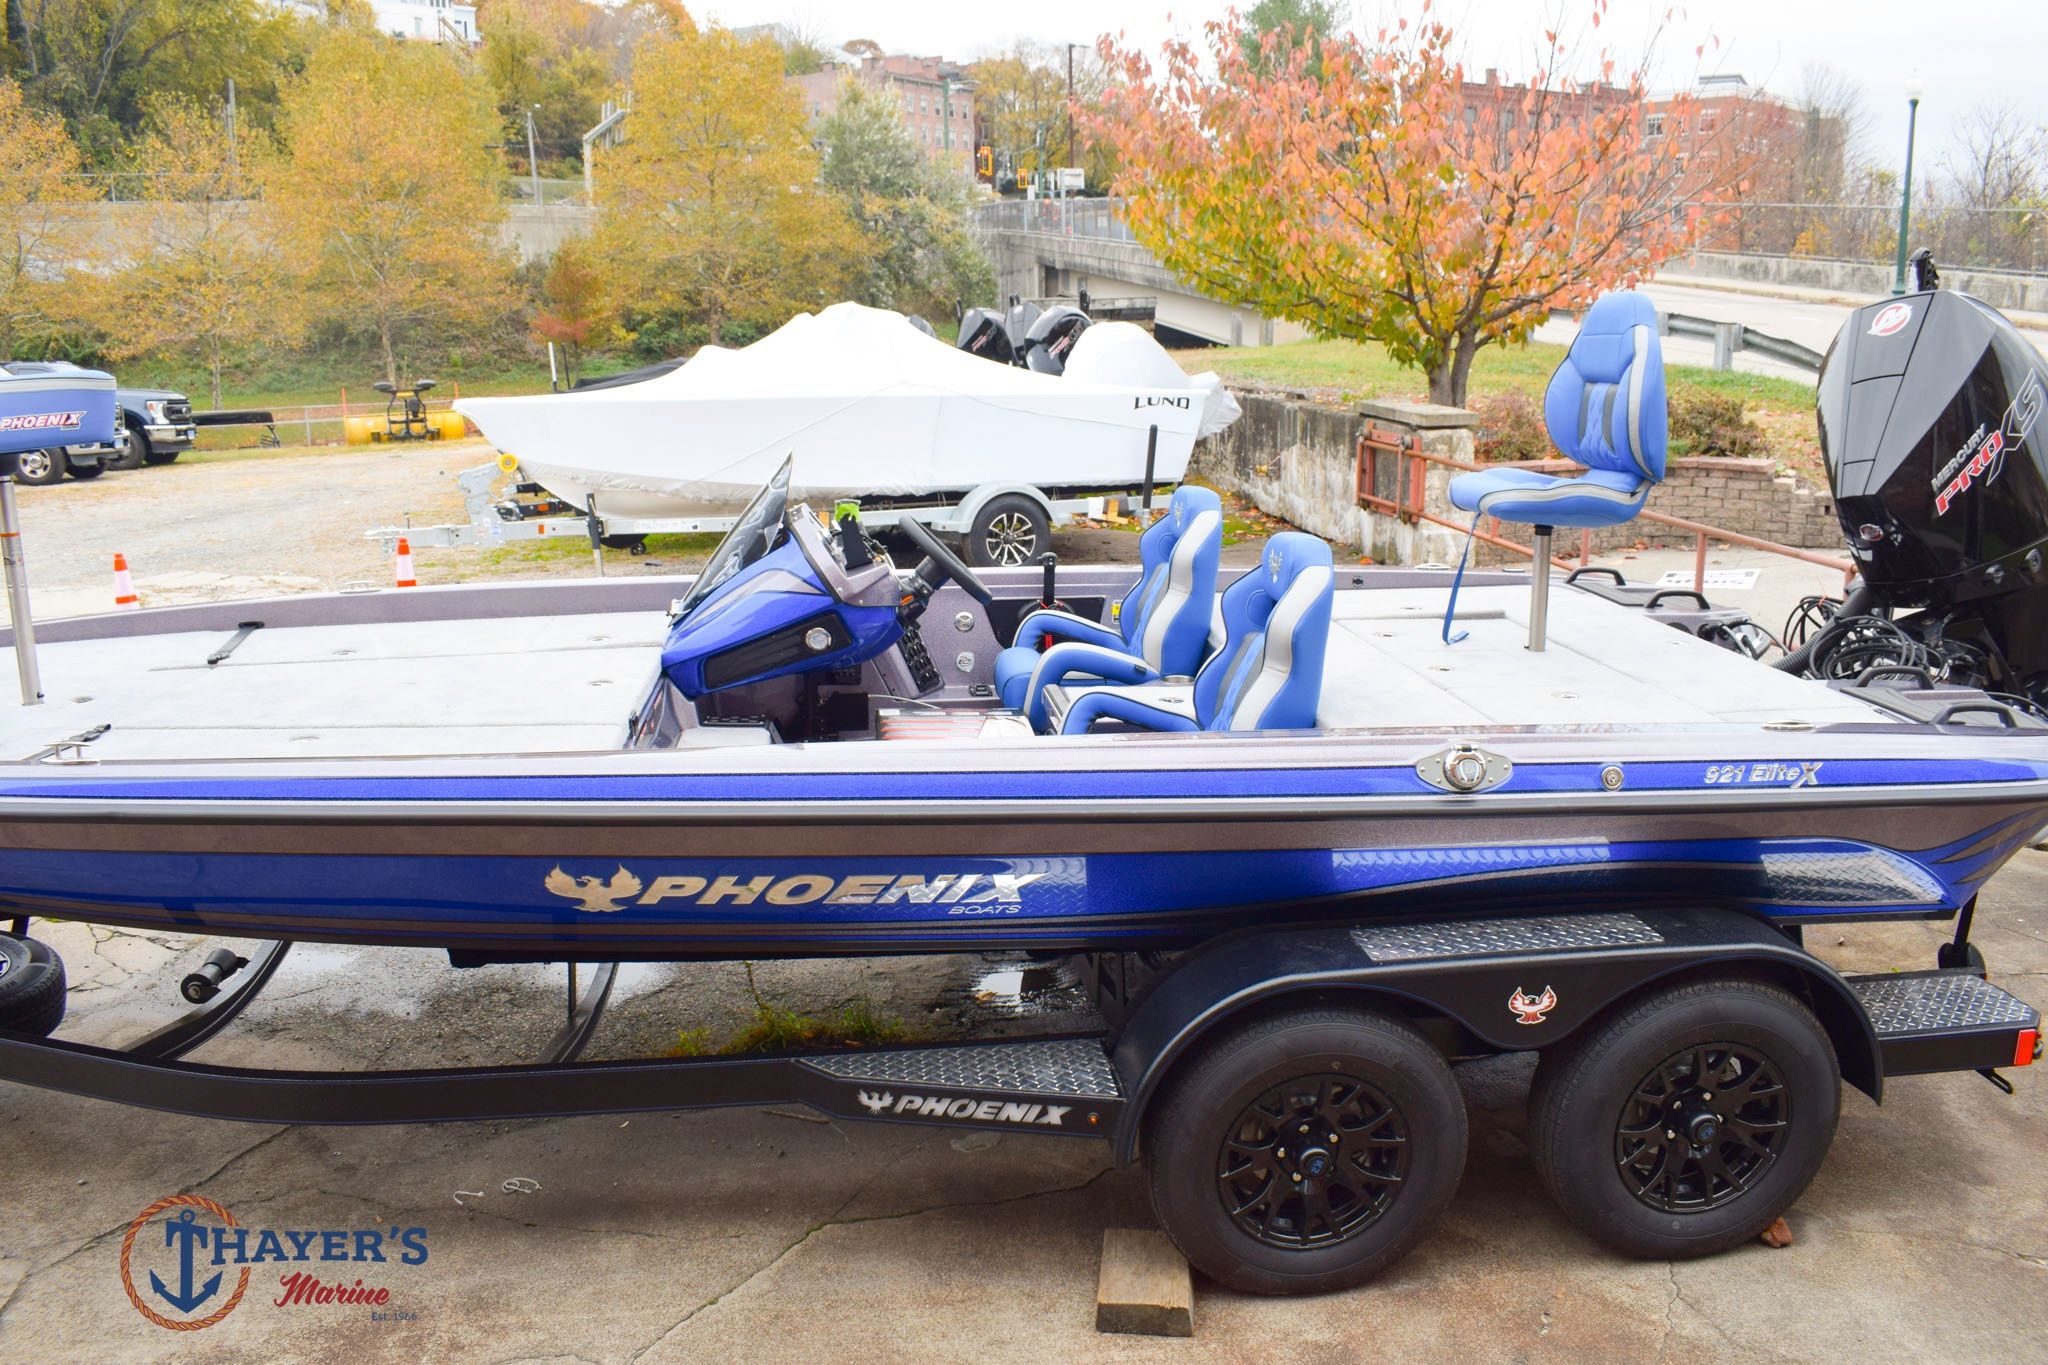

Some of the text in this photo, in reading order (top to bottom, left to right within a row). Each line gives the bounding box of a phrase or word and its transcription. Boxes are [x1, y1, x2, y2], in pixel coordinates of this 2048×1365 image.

[1133, 396, 1190, 410] LUND
[0, 412, 85, 430] PHOENIX
[1931, 423, 1986, 492] MERCURY
[1704, 765, 1746, 784] 921
[636, 872, 1049, 905] PHOENIX
[947, 904, 1022, 915] BOATS
[892, 1094, 1072, 1125] PHOENIX
